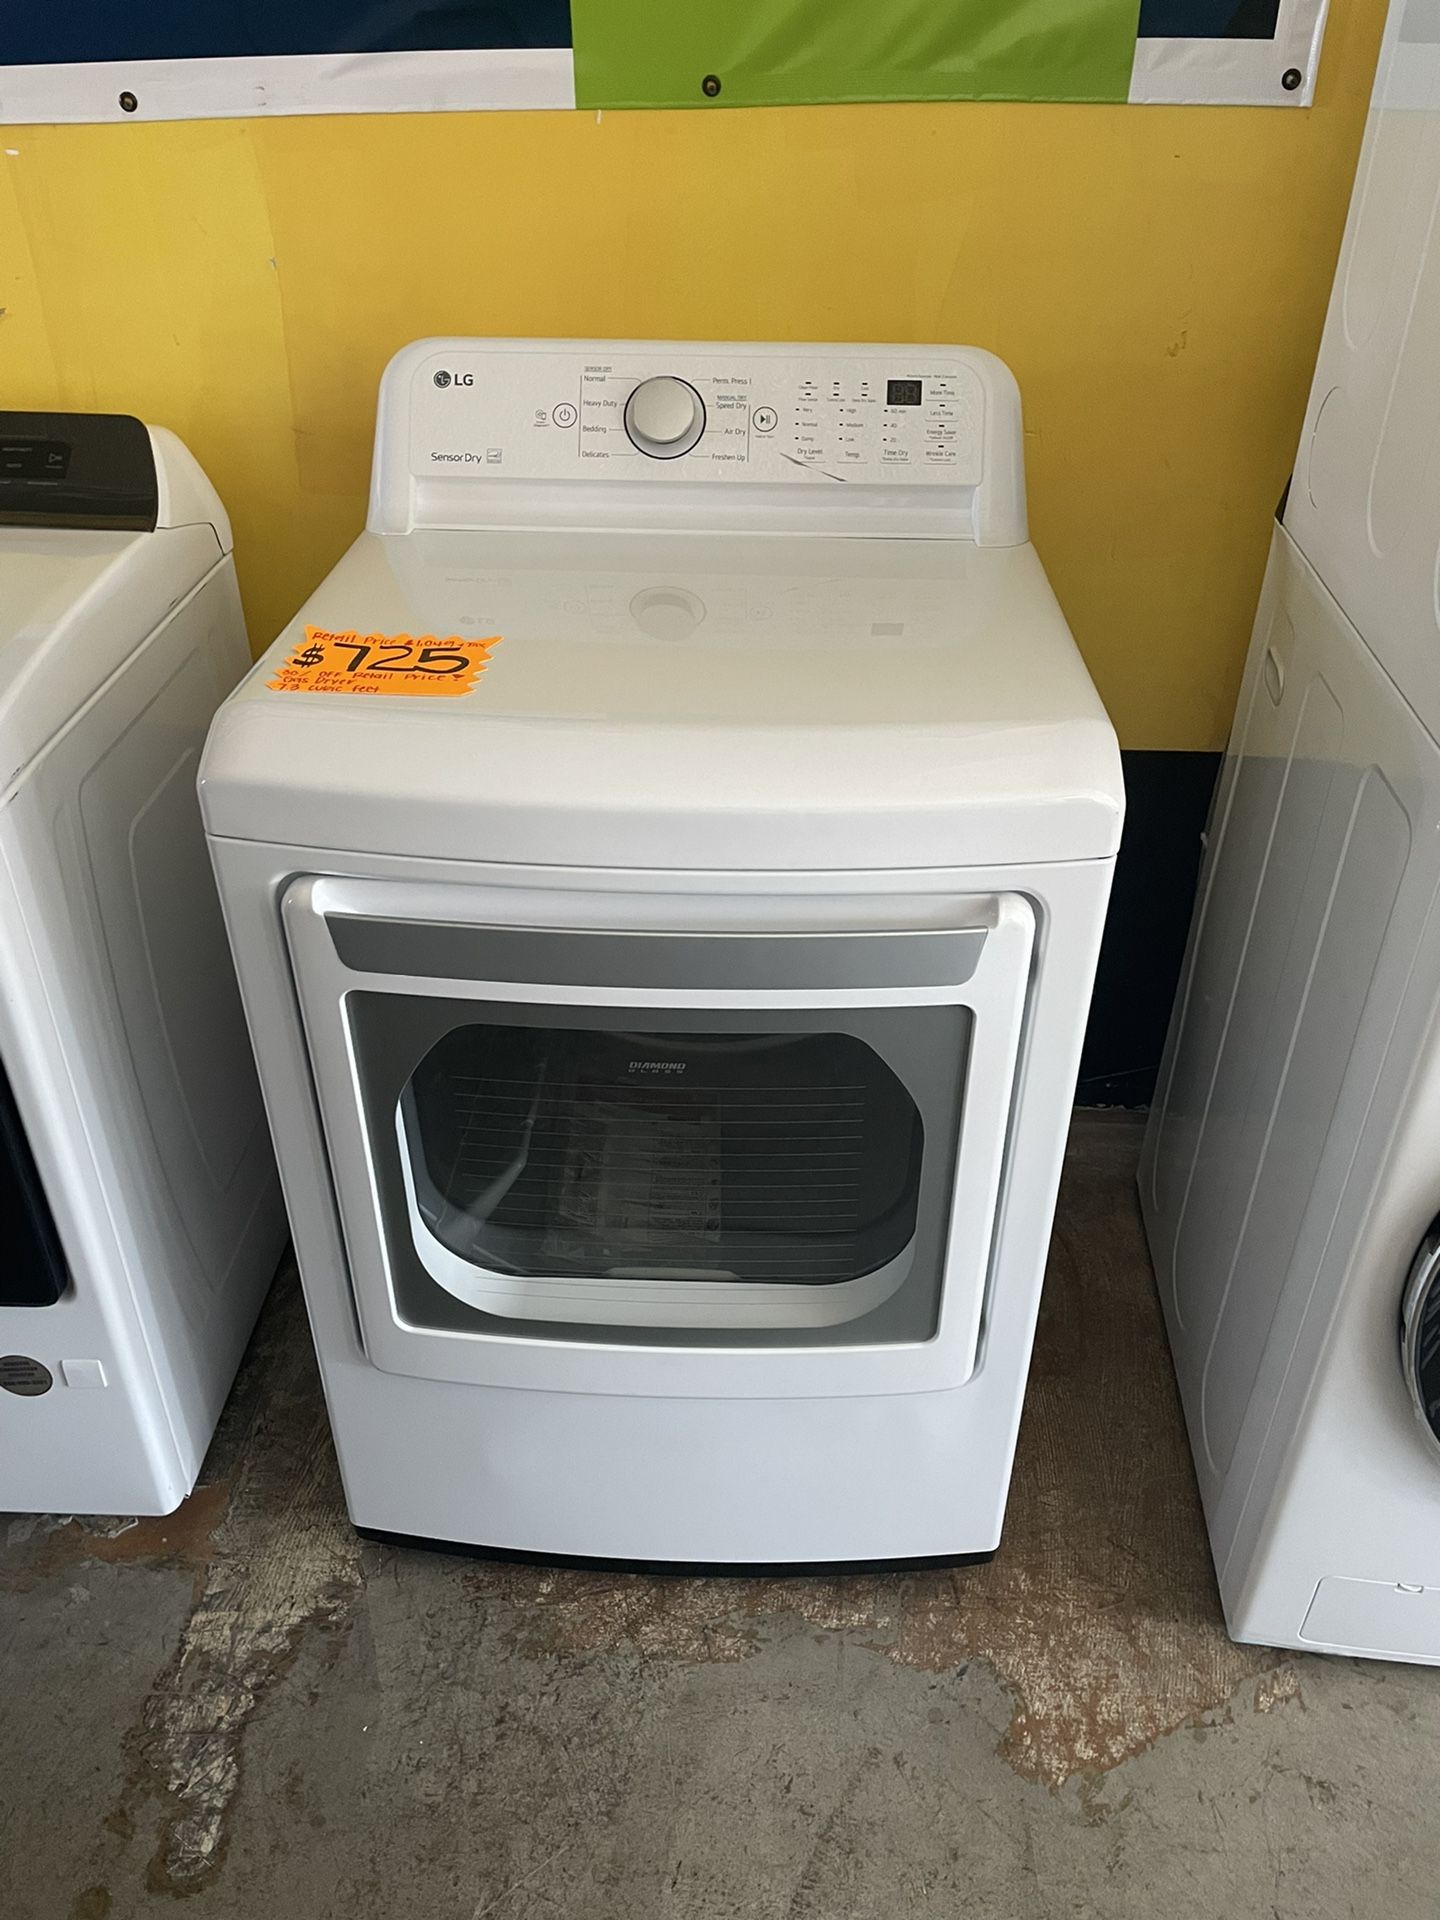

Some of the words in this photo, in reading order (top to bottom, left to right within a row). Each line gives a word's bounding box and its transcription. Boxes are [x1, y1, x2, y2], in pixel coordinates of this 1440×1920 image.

[454, 373, 474, 386] LG
[731, 377, 748, 385] Press
[583, 399, 601, 408] Heavy
[602, 399, 617, 408] Duty
[715, 401, 734, 410] Speed
[735, 402, 747, 411] Dry
[582, 425, 607, 434] Bedding
[734, 428, 747, 437] Dry
[430, 451, 464, 463] Sensor
[464, 452, 482, 465] Dry
[582, 450, 610, 459] Delicates
[711, 453, 736, 461] Freshen
[736, 454, 746, 462] Up
[363, 635, 397, 645] Price
[628, 1061, 687, 1070] DIAMOND
